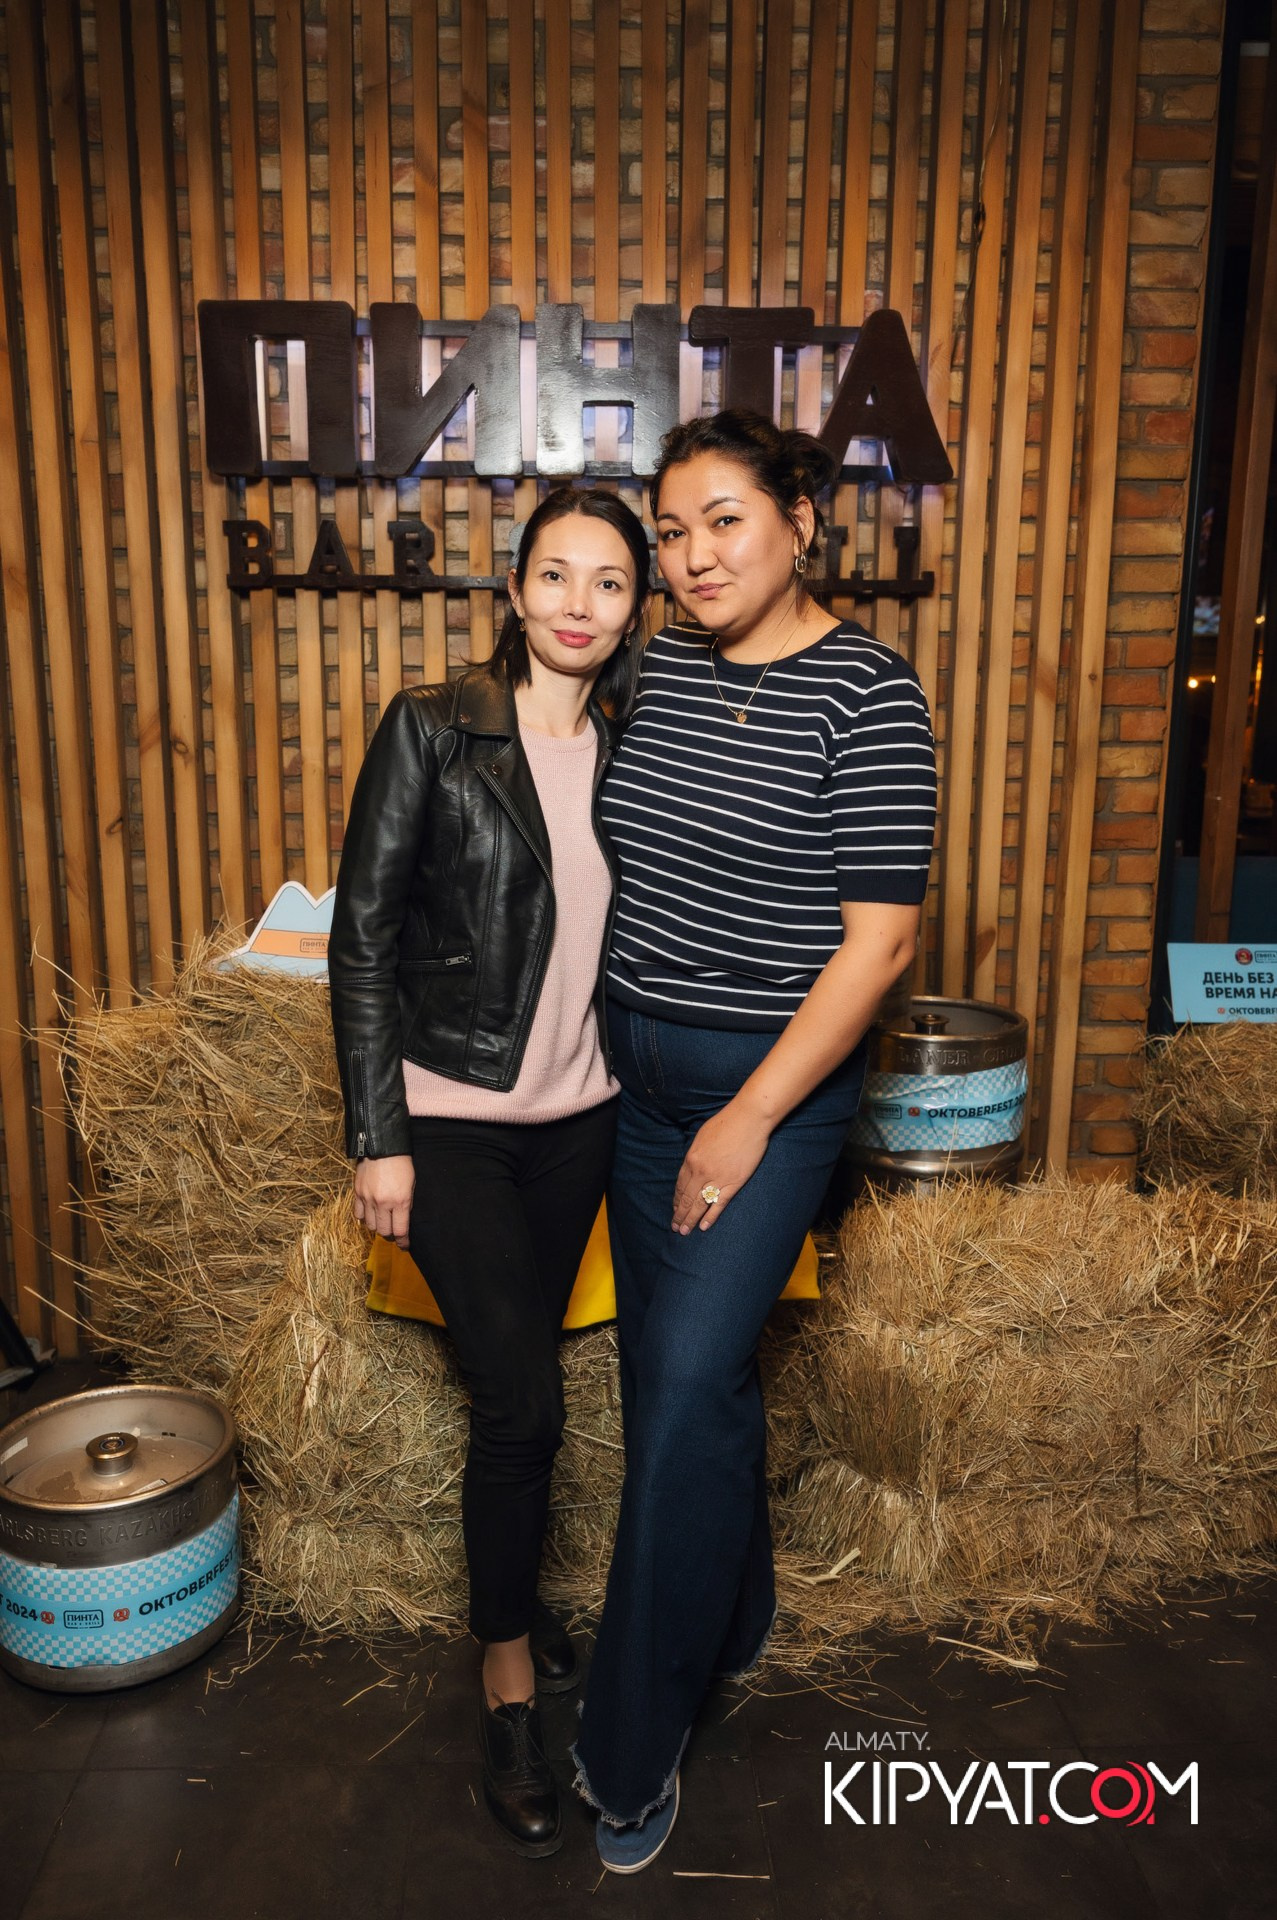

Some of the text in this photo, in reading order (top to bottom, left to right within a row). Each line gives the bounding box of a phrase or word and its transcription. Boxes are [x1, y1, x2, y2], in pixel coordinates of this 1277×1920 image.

[199, 300, 954, 484] ПИНТА
[226, 519, 438, 584] BAR
[1202, 971, 1275, 985] ДЕНЬ БЕЗ
[1205, 987, 1256, 999] ВРЕМЯ
[927, 1098, 1014, 1119] OKTOBERFEST
[138, 1545, 234, 1616] OKTOBERFEST
[5, 1598, 38, 1621] 2024
[67, 1614, 100, 1622] ПИНТА
